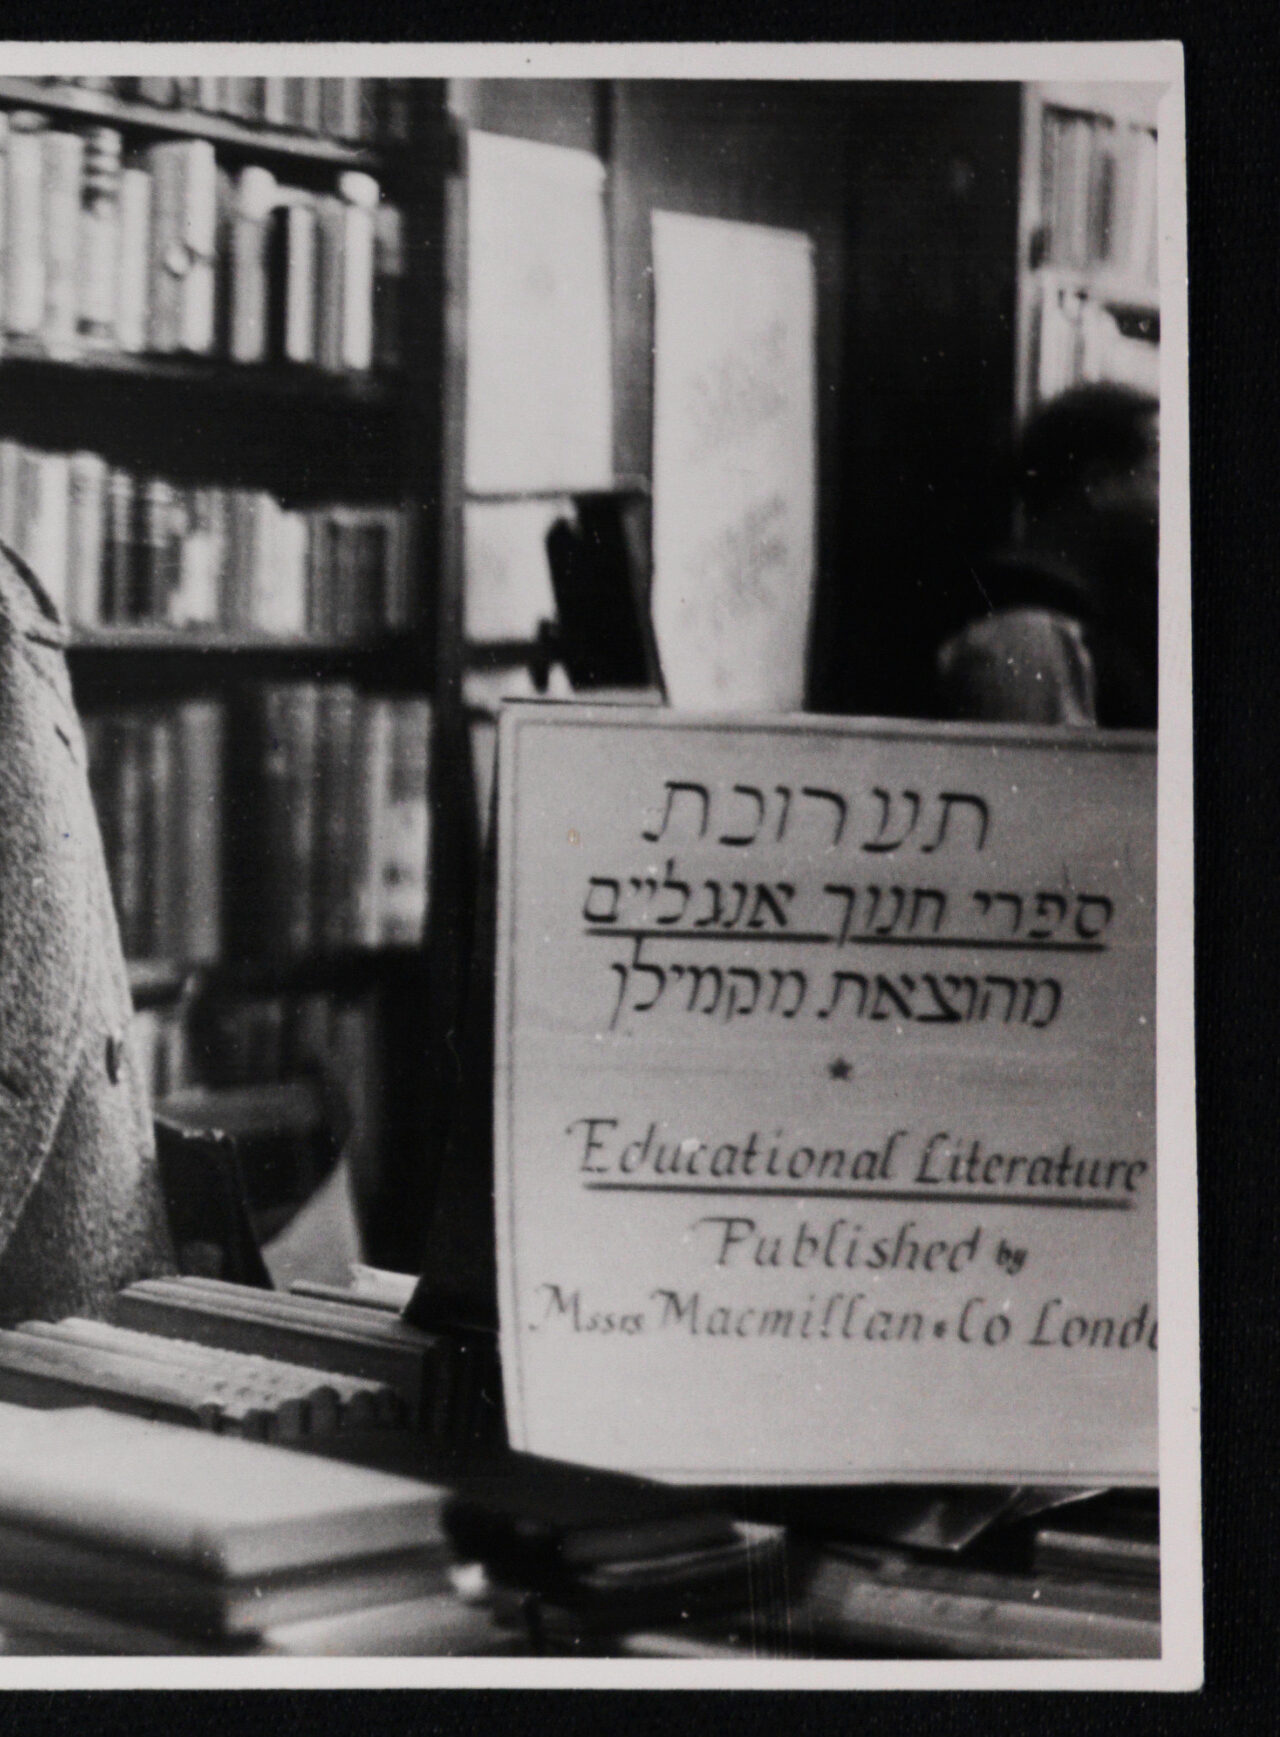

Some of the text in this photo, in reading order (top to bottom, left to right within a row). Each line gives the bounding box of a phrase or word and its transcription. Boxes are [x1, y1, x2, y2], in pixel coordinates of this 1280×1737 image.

[642, 780, 990, 852] תערוכת
[582, 857, 1115, 949] ספרי חנוך אנגליים
[606, 934, 1062, 1032] מהוצאת מקמילן
[564, 1117, 1148, 1195] Educational Literature
[690, 1216, 984, 1272] Published
[648, 1286, 924, 1343] Macmillan
[956, 1297, 1013, 1347] Co
